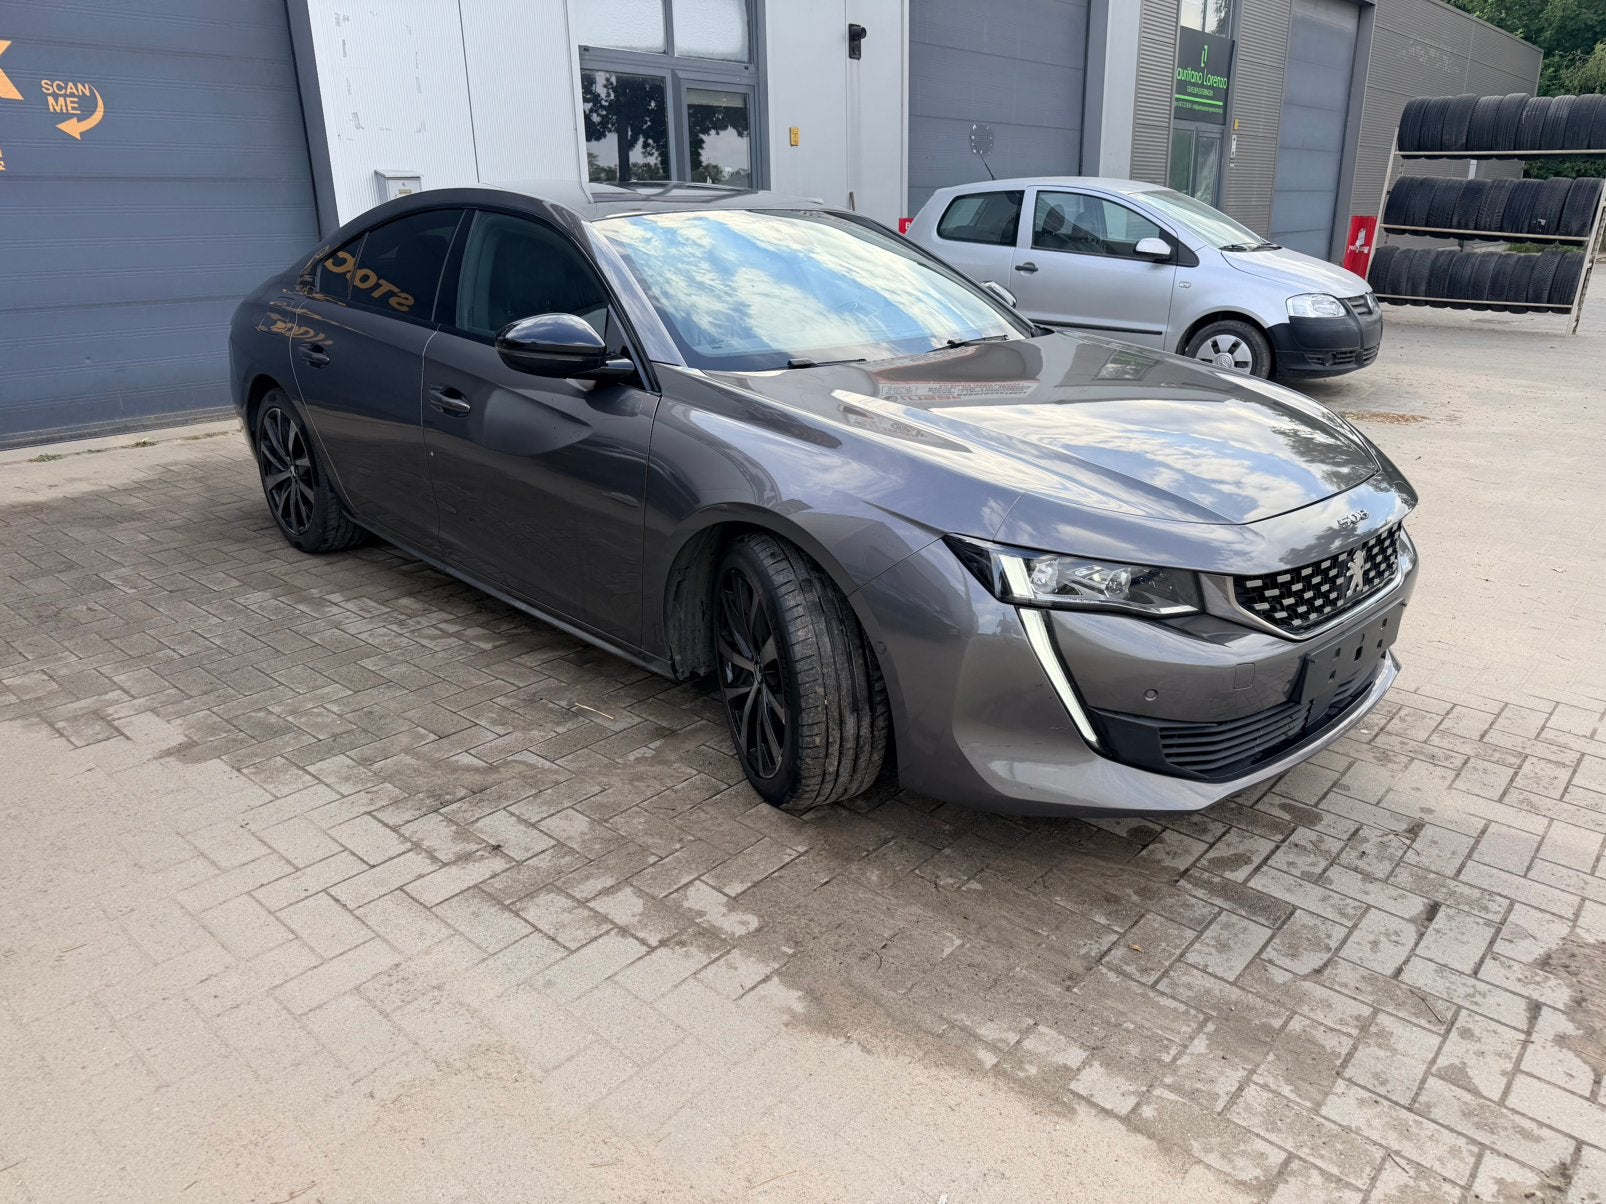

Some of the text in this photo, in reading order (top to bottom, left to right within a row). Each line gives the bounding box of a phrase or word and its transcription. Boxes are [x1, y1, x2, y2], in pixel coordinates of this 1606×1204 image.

[41, 79, 90, 96] SCAN
[47, 95, 81, 114] ME
[1337, 508, 1370, 529] 508
